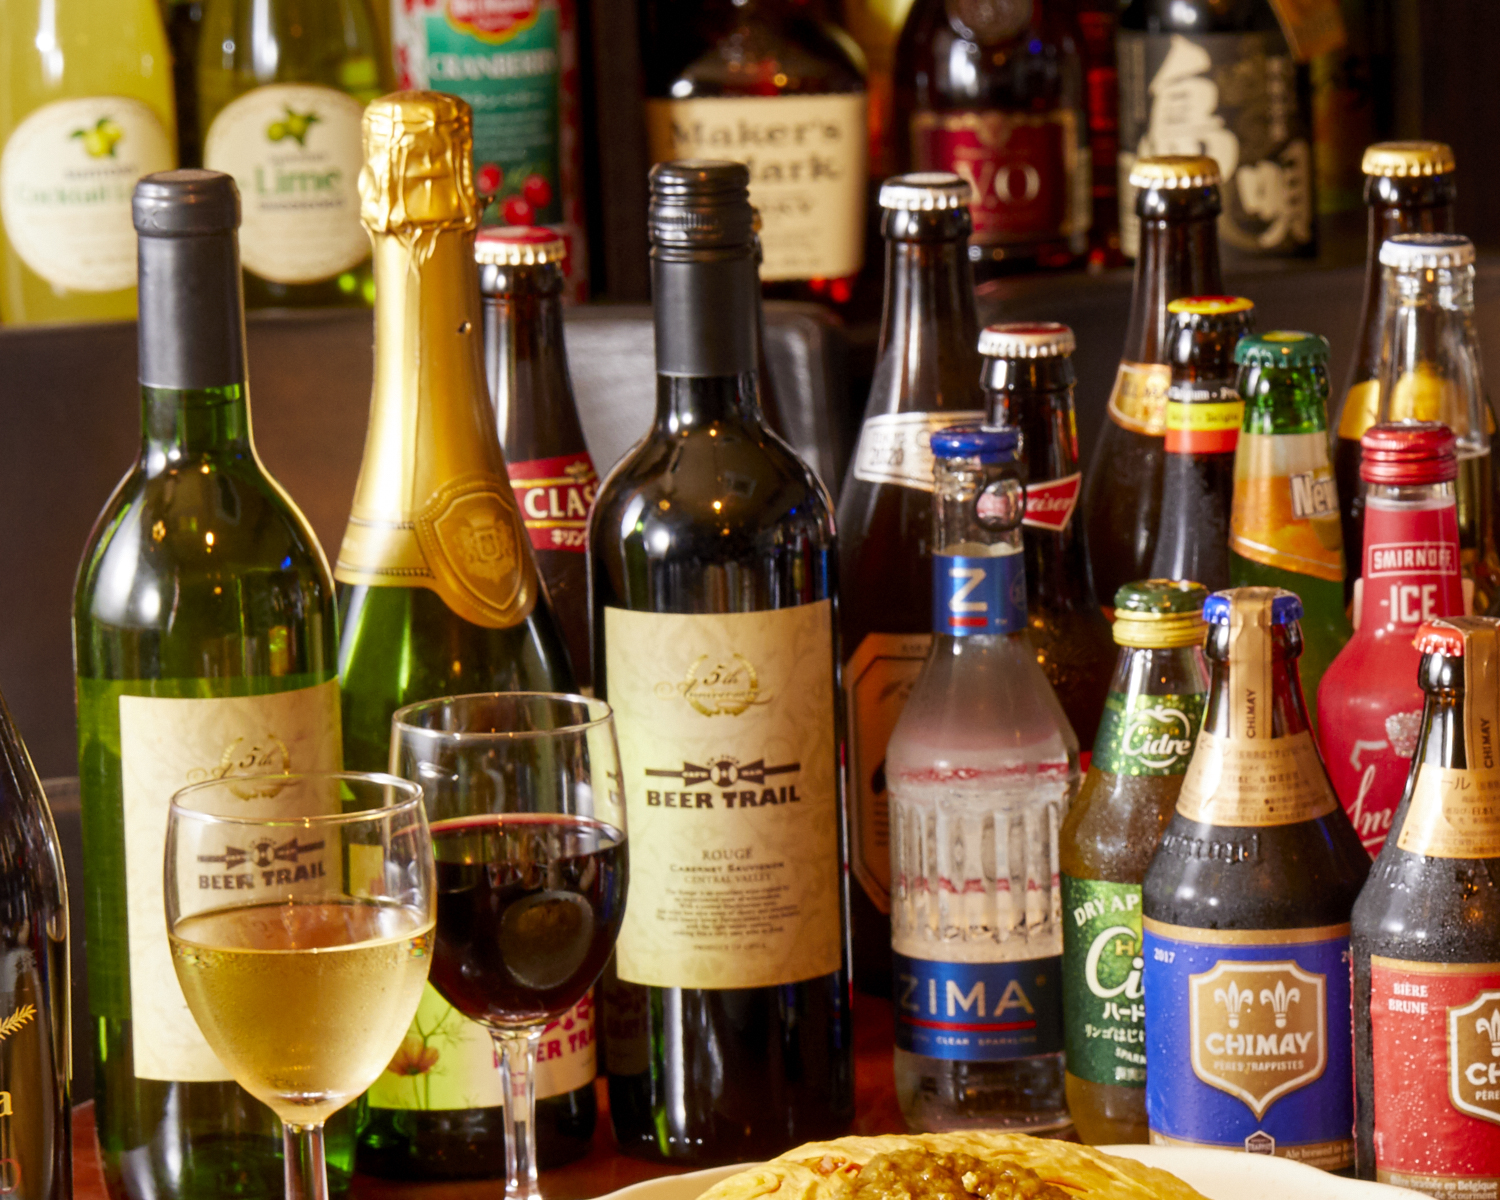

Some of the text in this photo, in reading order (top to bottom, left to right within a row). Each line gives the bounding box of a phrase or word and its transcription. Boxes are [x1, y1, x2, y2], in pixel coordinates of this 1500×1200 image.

[1373, 548, 1453, 570] SMIRNOFF
[948, 567, 989, 612] Z
[1246, 688, 1257, 739] CHIMAY
[1122, 724, 1193, 757] Cidre
[1483, 718, 1494, 769] CHIMAY
[646, 785, 802, 810] BEER TRAIL
[198, 860, 327, 890] BEER TRAIL
[1072, 896, 1106, 928] DRY
[1153, 947, 1176, 964] 2017
[900, 973, 1036, 1018] ZIMA
[1393, 982, 1429, 998] BIÈRE
[1388, 999, 1429, 1016] BRUNE
[1204, 1030, 1314, 1057] CHIMAY
[1213, 1059, 1305, 1073] PÈRES TRAPPISTES
